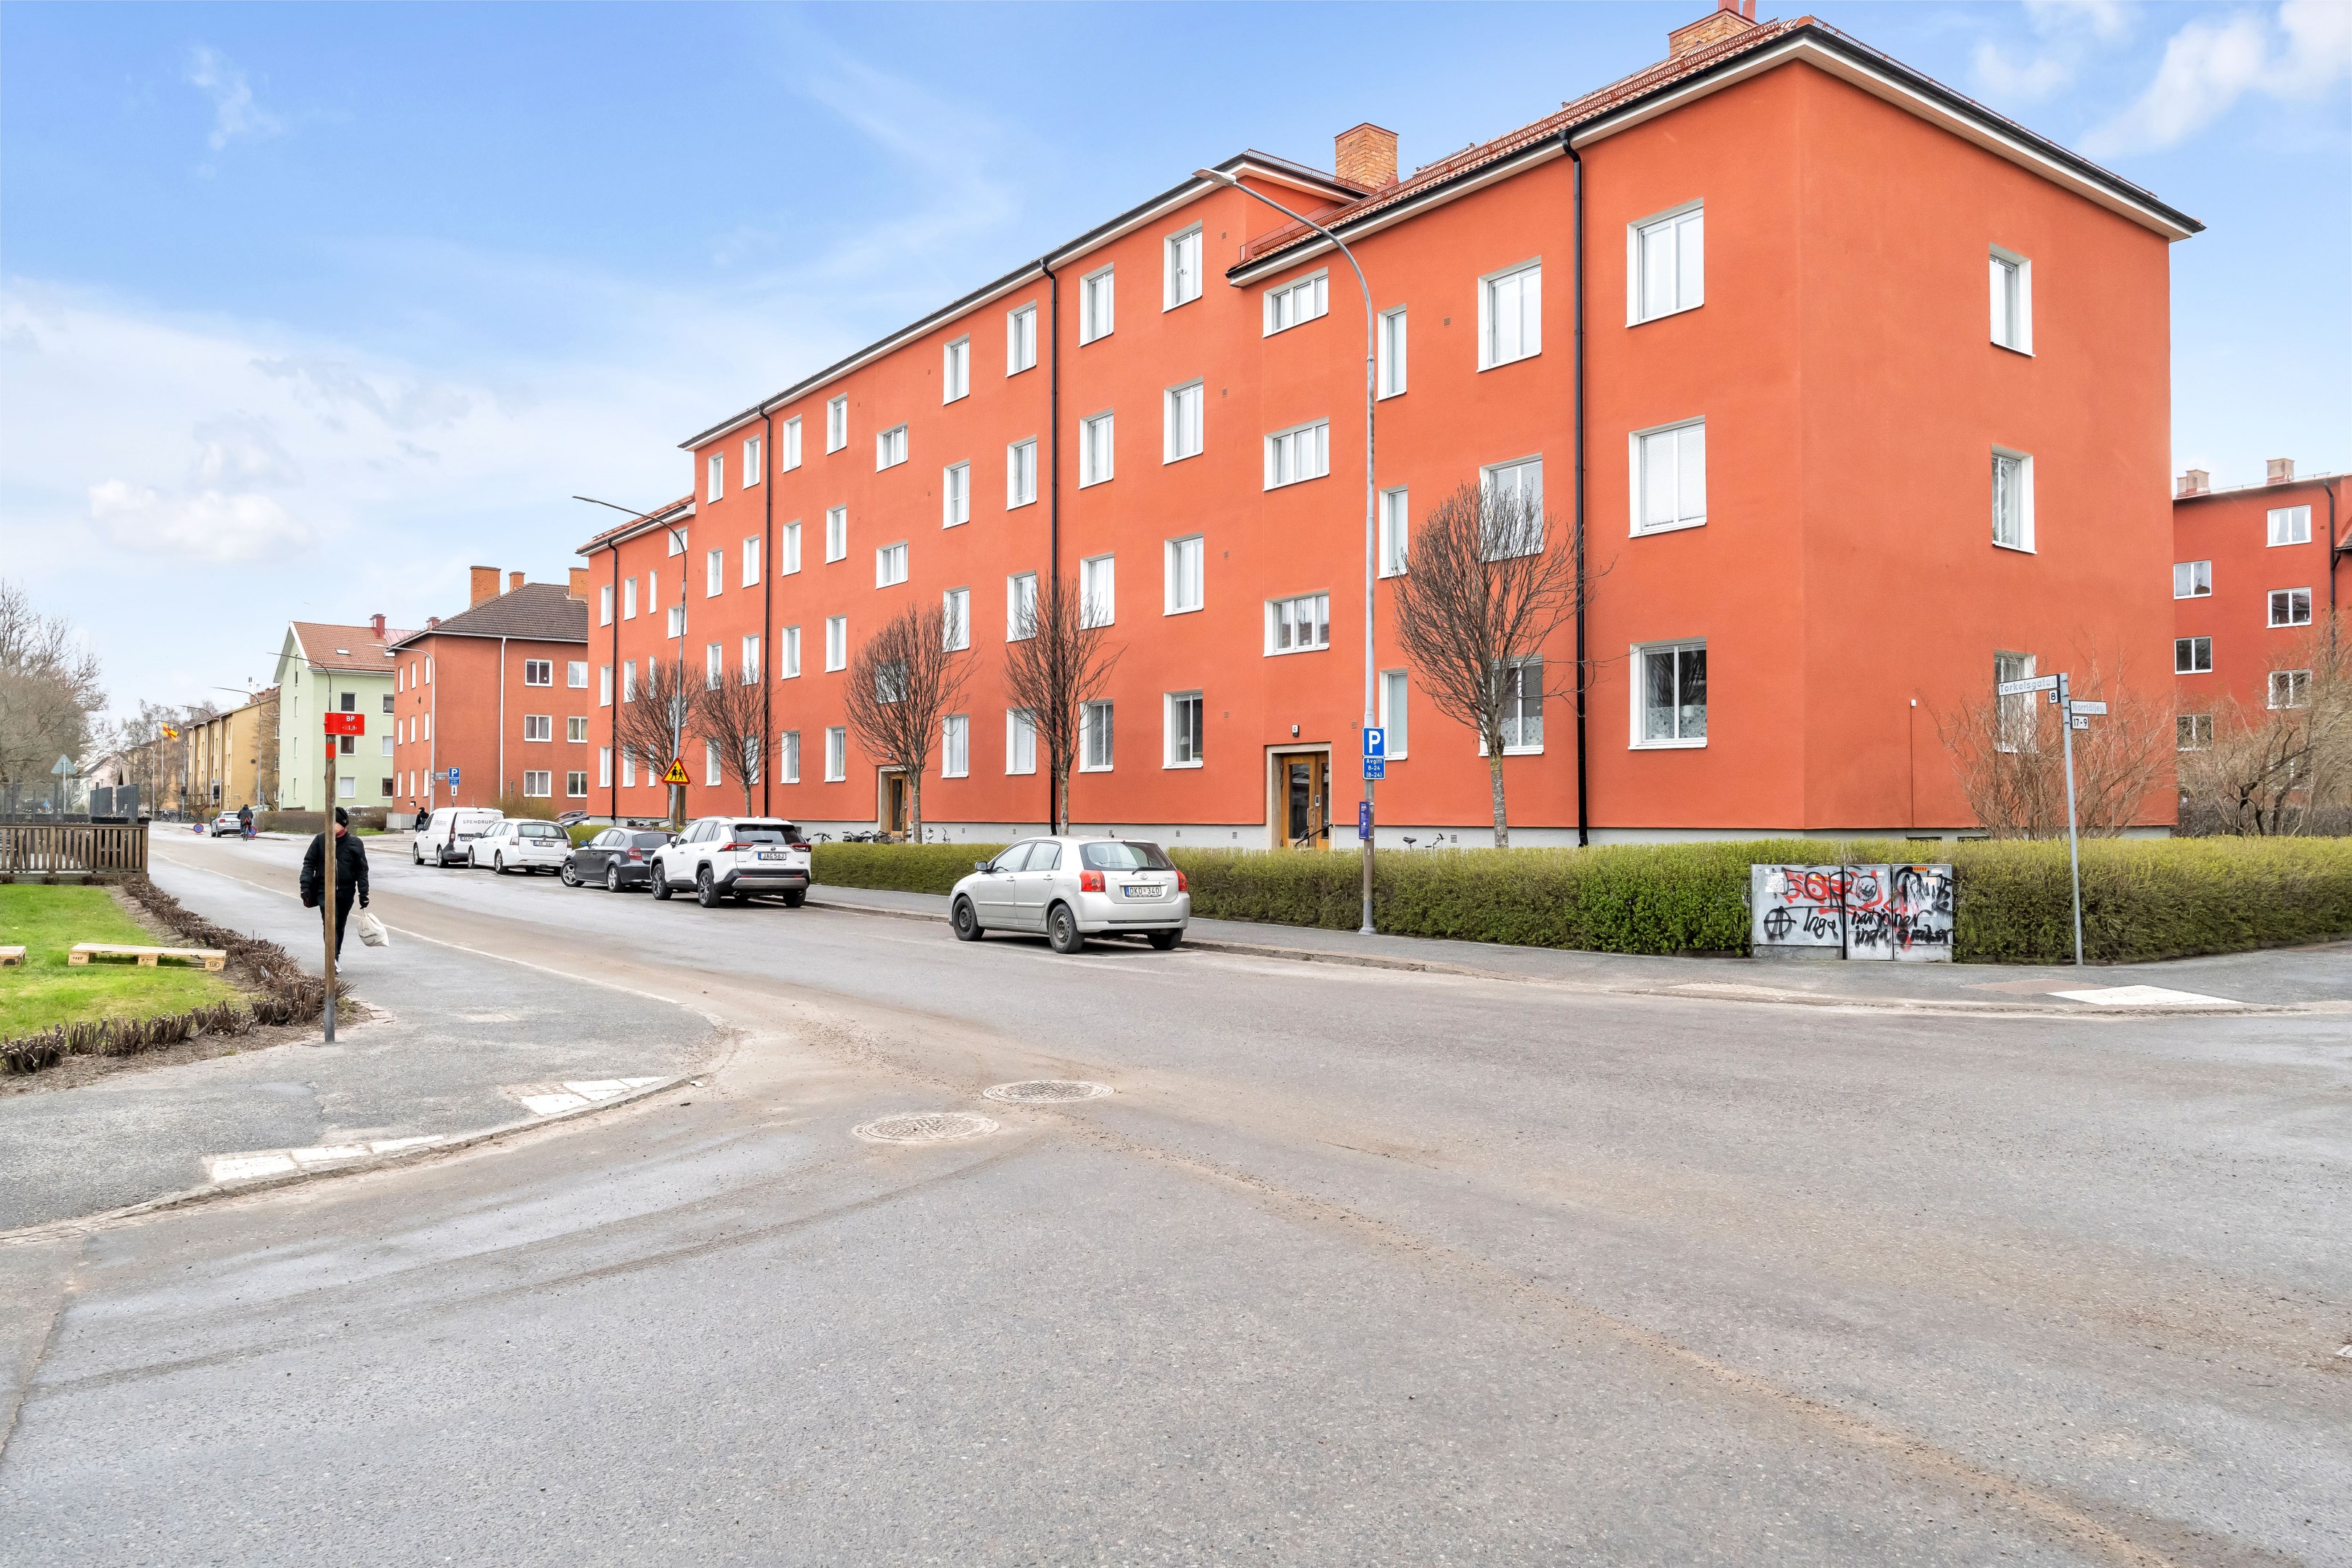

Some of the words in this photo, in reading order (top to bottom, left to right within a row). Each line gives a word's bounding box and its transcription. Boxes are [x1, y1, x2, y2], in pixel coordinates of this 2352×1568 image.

[2000, 678, 2057, 693] Torkelsgatan
[1368, 730, 1381, 754] P
[452, 768, 458, 777] P
